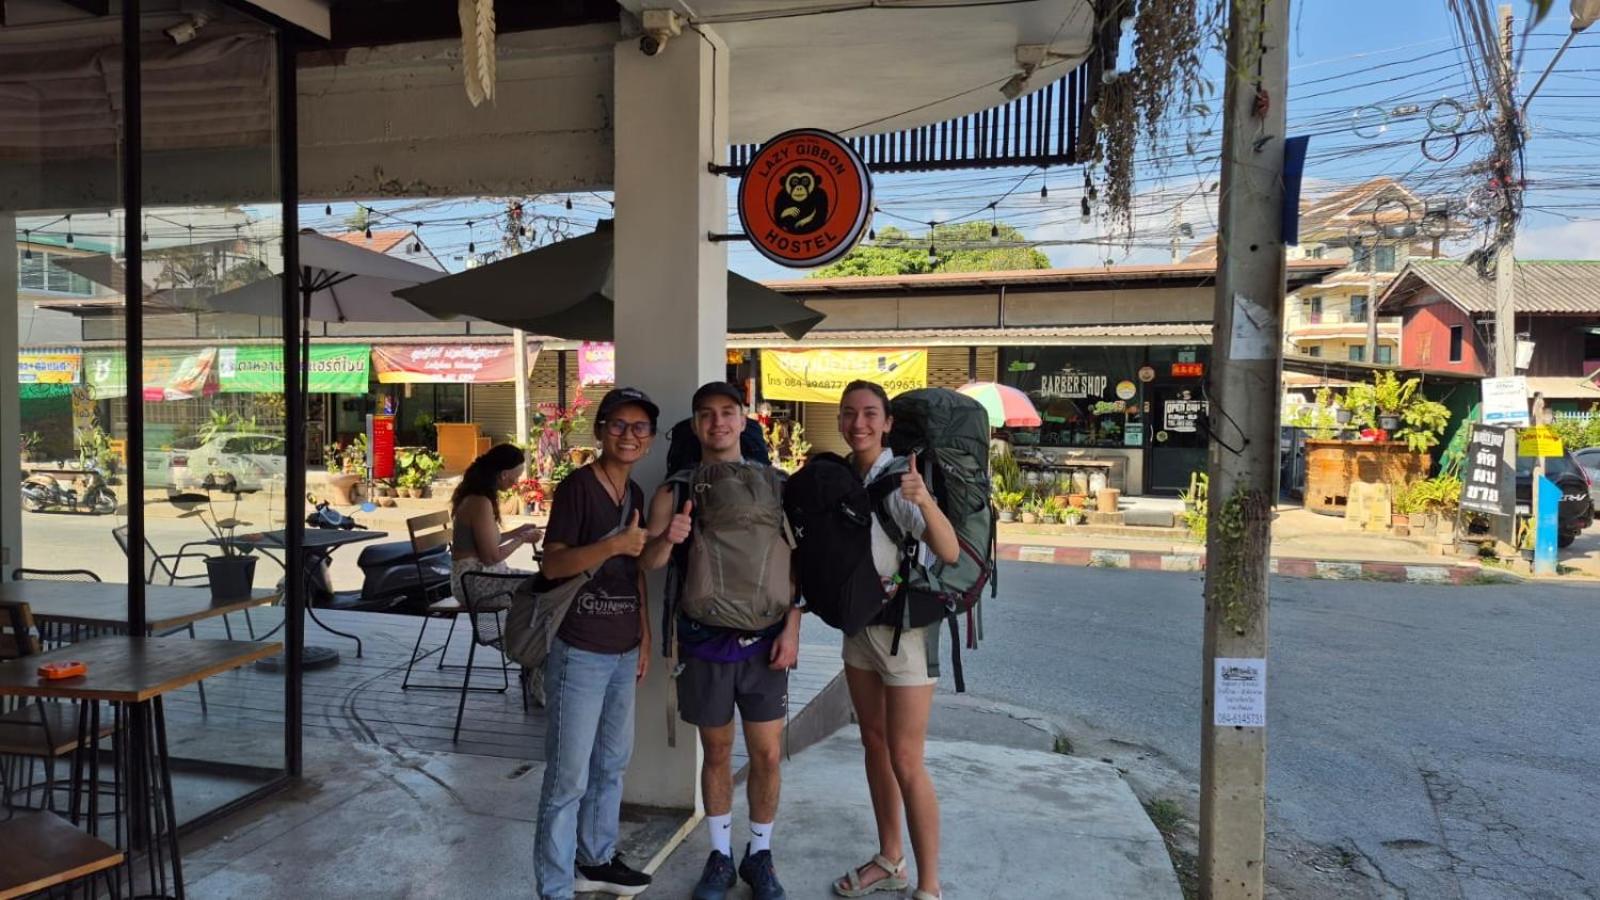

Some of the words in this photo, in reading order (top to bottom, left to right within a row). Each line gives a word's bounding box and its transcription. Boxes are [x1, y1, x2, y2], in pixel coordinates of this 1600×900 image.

[758, 146, 790, 178] LAZY
[796, 144, 846, 175] GIBBON
[765, 230, 837, 253] HOSTEL
[1041, 375, 1080, 397] BARBER
[1082, 376, 1107, 398] SHOP
